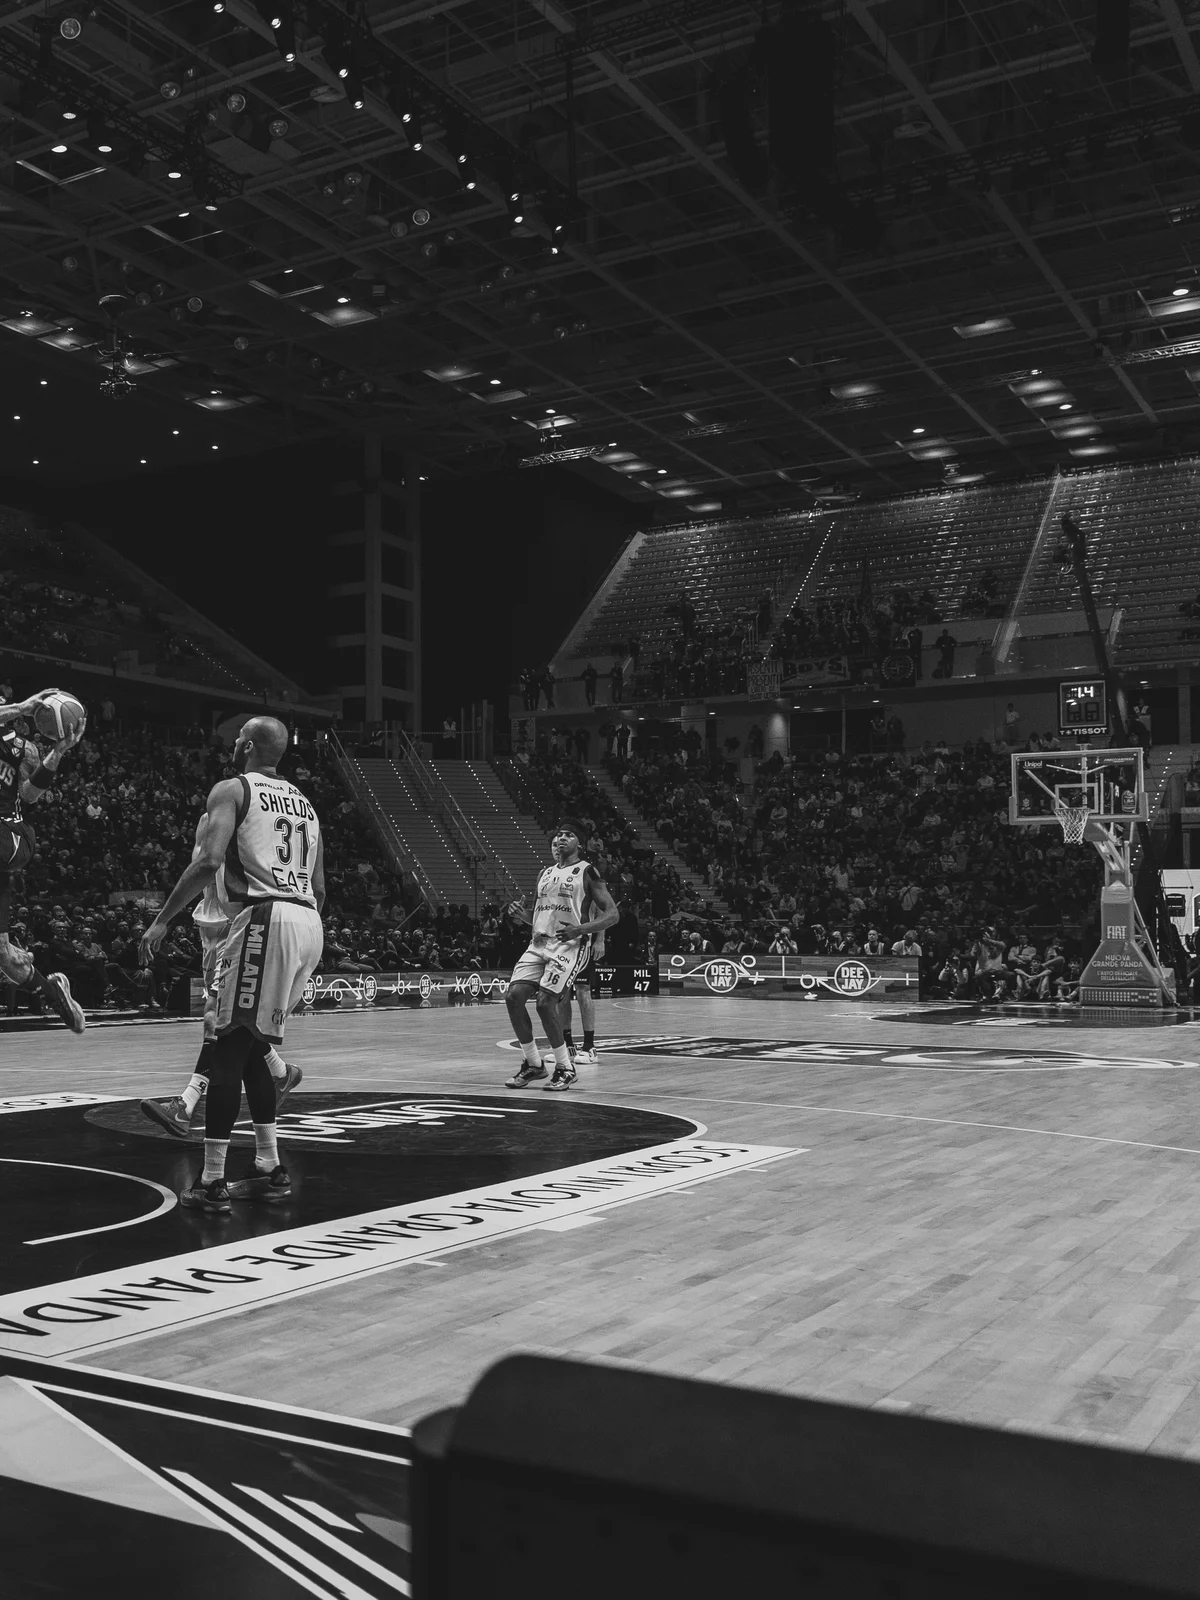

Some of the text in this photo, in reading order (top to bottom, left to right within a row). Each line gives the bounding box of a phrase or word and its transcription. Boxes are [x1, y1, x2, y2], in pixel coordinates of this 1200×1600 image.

[1073, 727, 1107, 735] TISSOT
[259, 792, 314, 821] SHIELDS
[274, 816, 309, 869] 31
[271, 866, 308, 894] EA7
[1107, 925, 1127, 939] FIAT
[237, 923, 265, 1009] MILANO
[634, 969, 651, 977] MIL
[710, 965, 732, 976] DEE
[841, 967, 864, 979] DEE
[365, 979, 376, 988] DEE
[546, 972, 560, 985] 16
[600, 973, 613, 981] 1.7
[634, 981, 650, 991] 47
[729, 1043, 913, 1061] LBA
[230, 1103, 538, 1144] Unipol
[636, 1144, 749, 1178] SCOPRI
[451, 1175, 634, 1213] NUOVA
[225, 1212, 485, 1271] GRANDE
